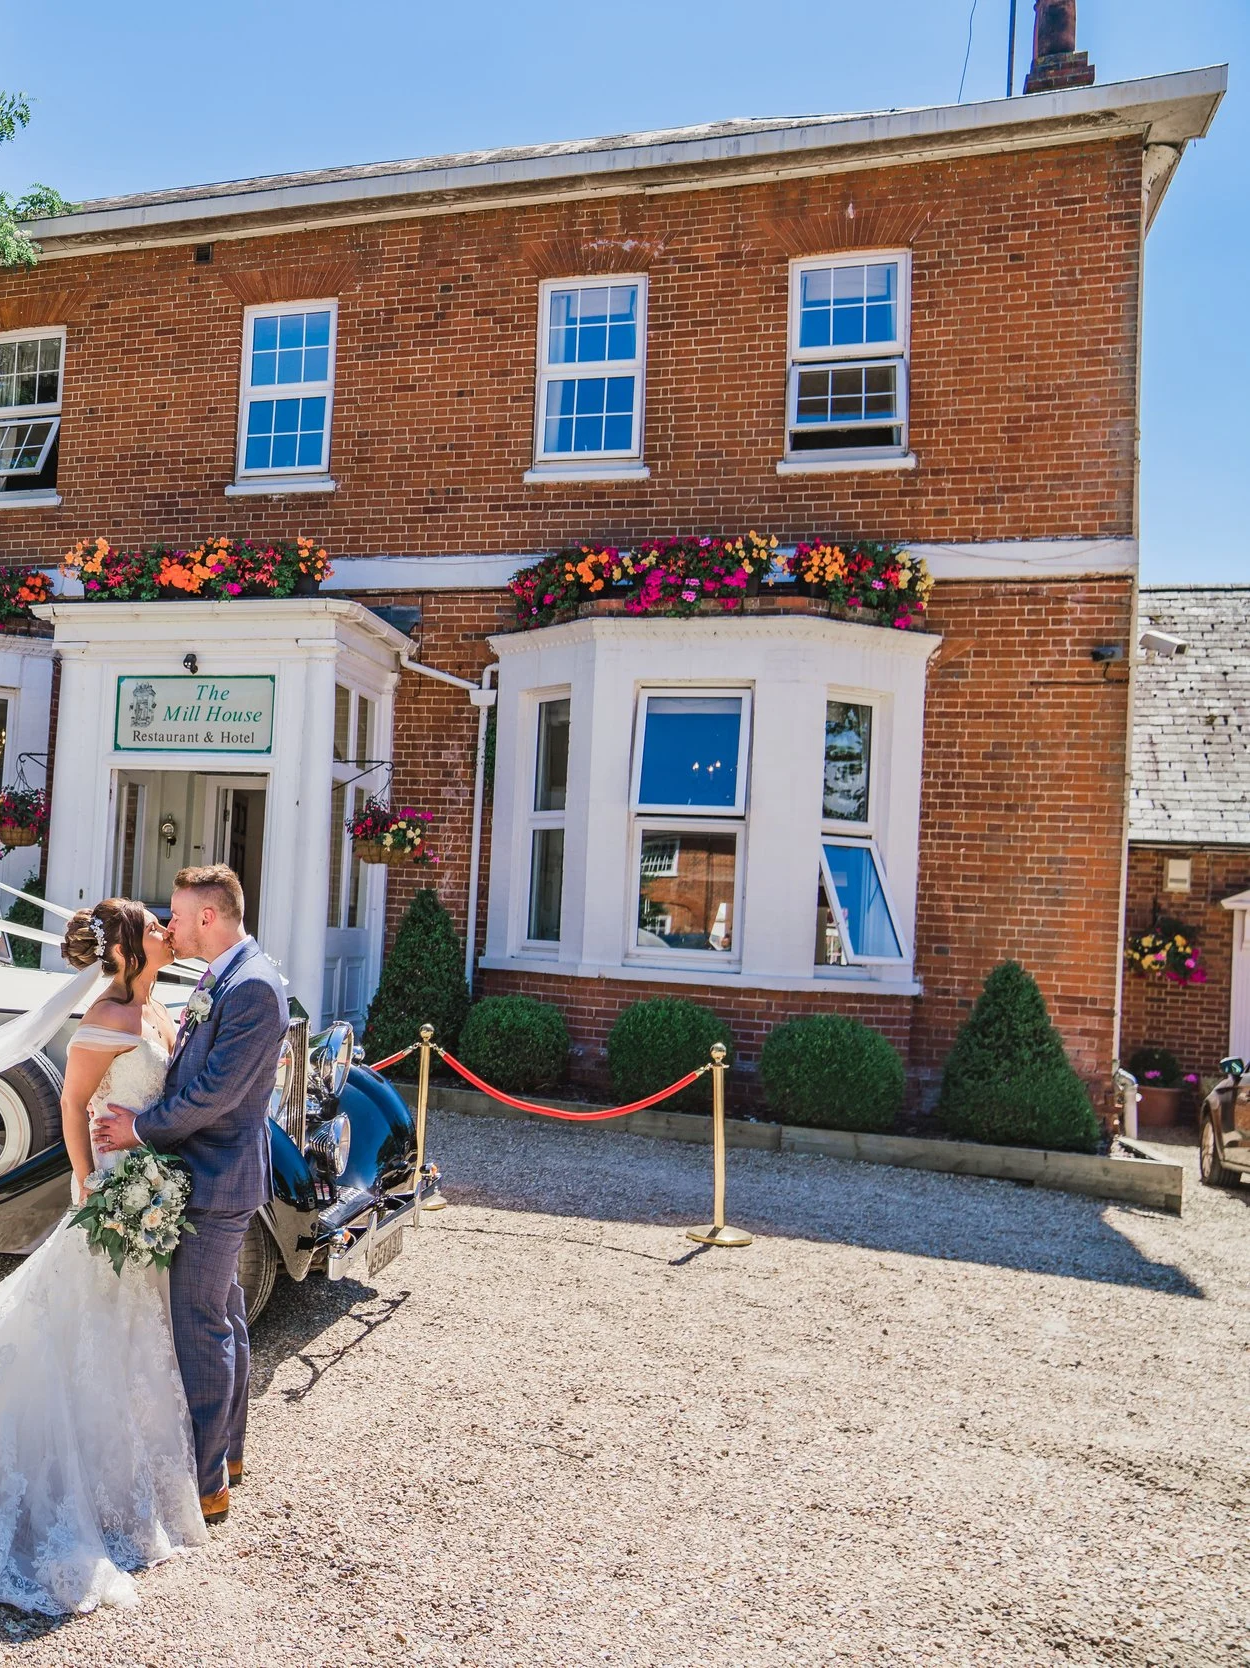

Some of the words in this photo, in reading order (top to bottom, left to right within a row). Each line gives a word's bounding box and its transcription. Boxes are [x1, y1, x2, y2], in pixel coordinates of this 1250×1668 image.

[196, 684, 230, 701] The
[162, 705, 200, 722] Mill
[205, 705, 262, 723] House
[132, 730, 199, 743] Restaurant
[203, 731, 214, 743] &
[220, 731, 255, 744] Hotel
